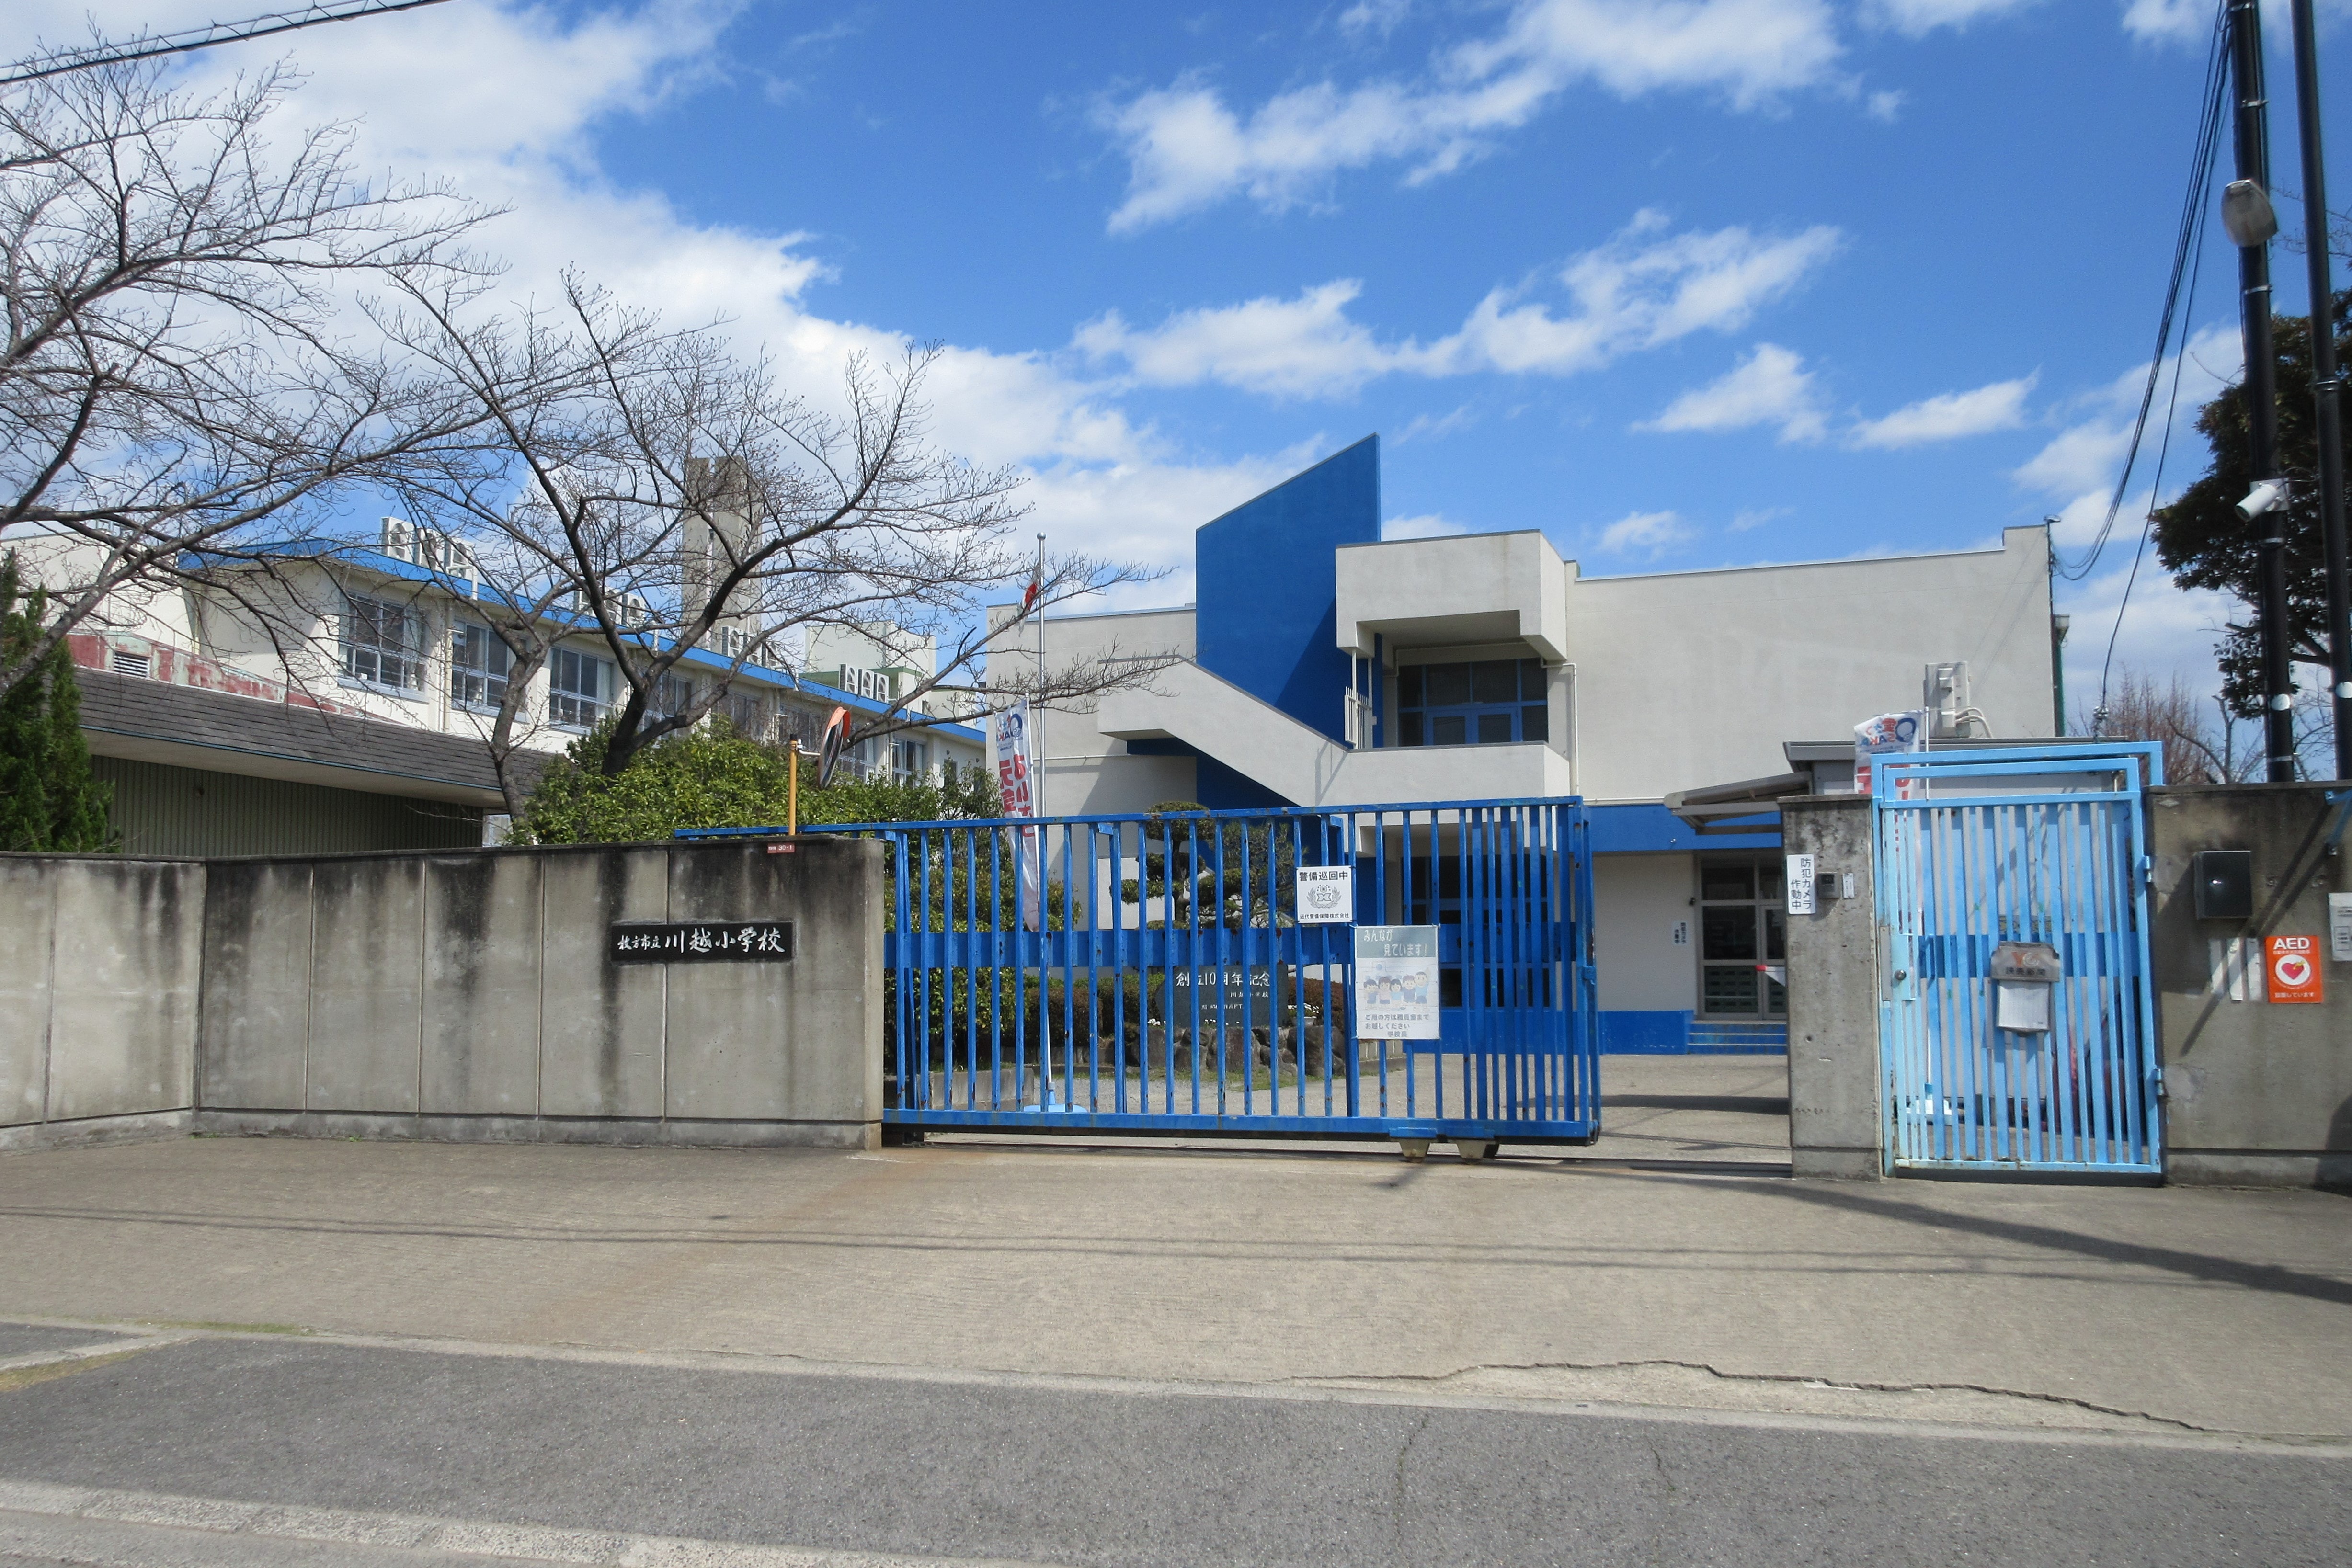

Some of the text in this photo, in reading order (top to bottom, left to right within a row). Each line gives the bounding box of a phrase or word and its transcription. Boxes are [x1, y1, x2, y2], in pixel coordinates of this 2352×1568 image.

[1299, 870, 1348, 881] 警備巡回中
[1800, 858, 1812, 909] 防犯カメラ
[1791, 879, 1801, 909] 作動中
[1363, 929, 1393, 942] みんなが
[2273, 937, 2310, 950] AED
